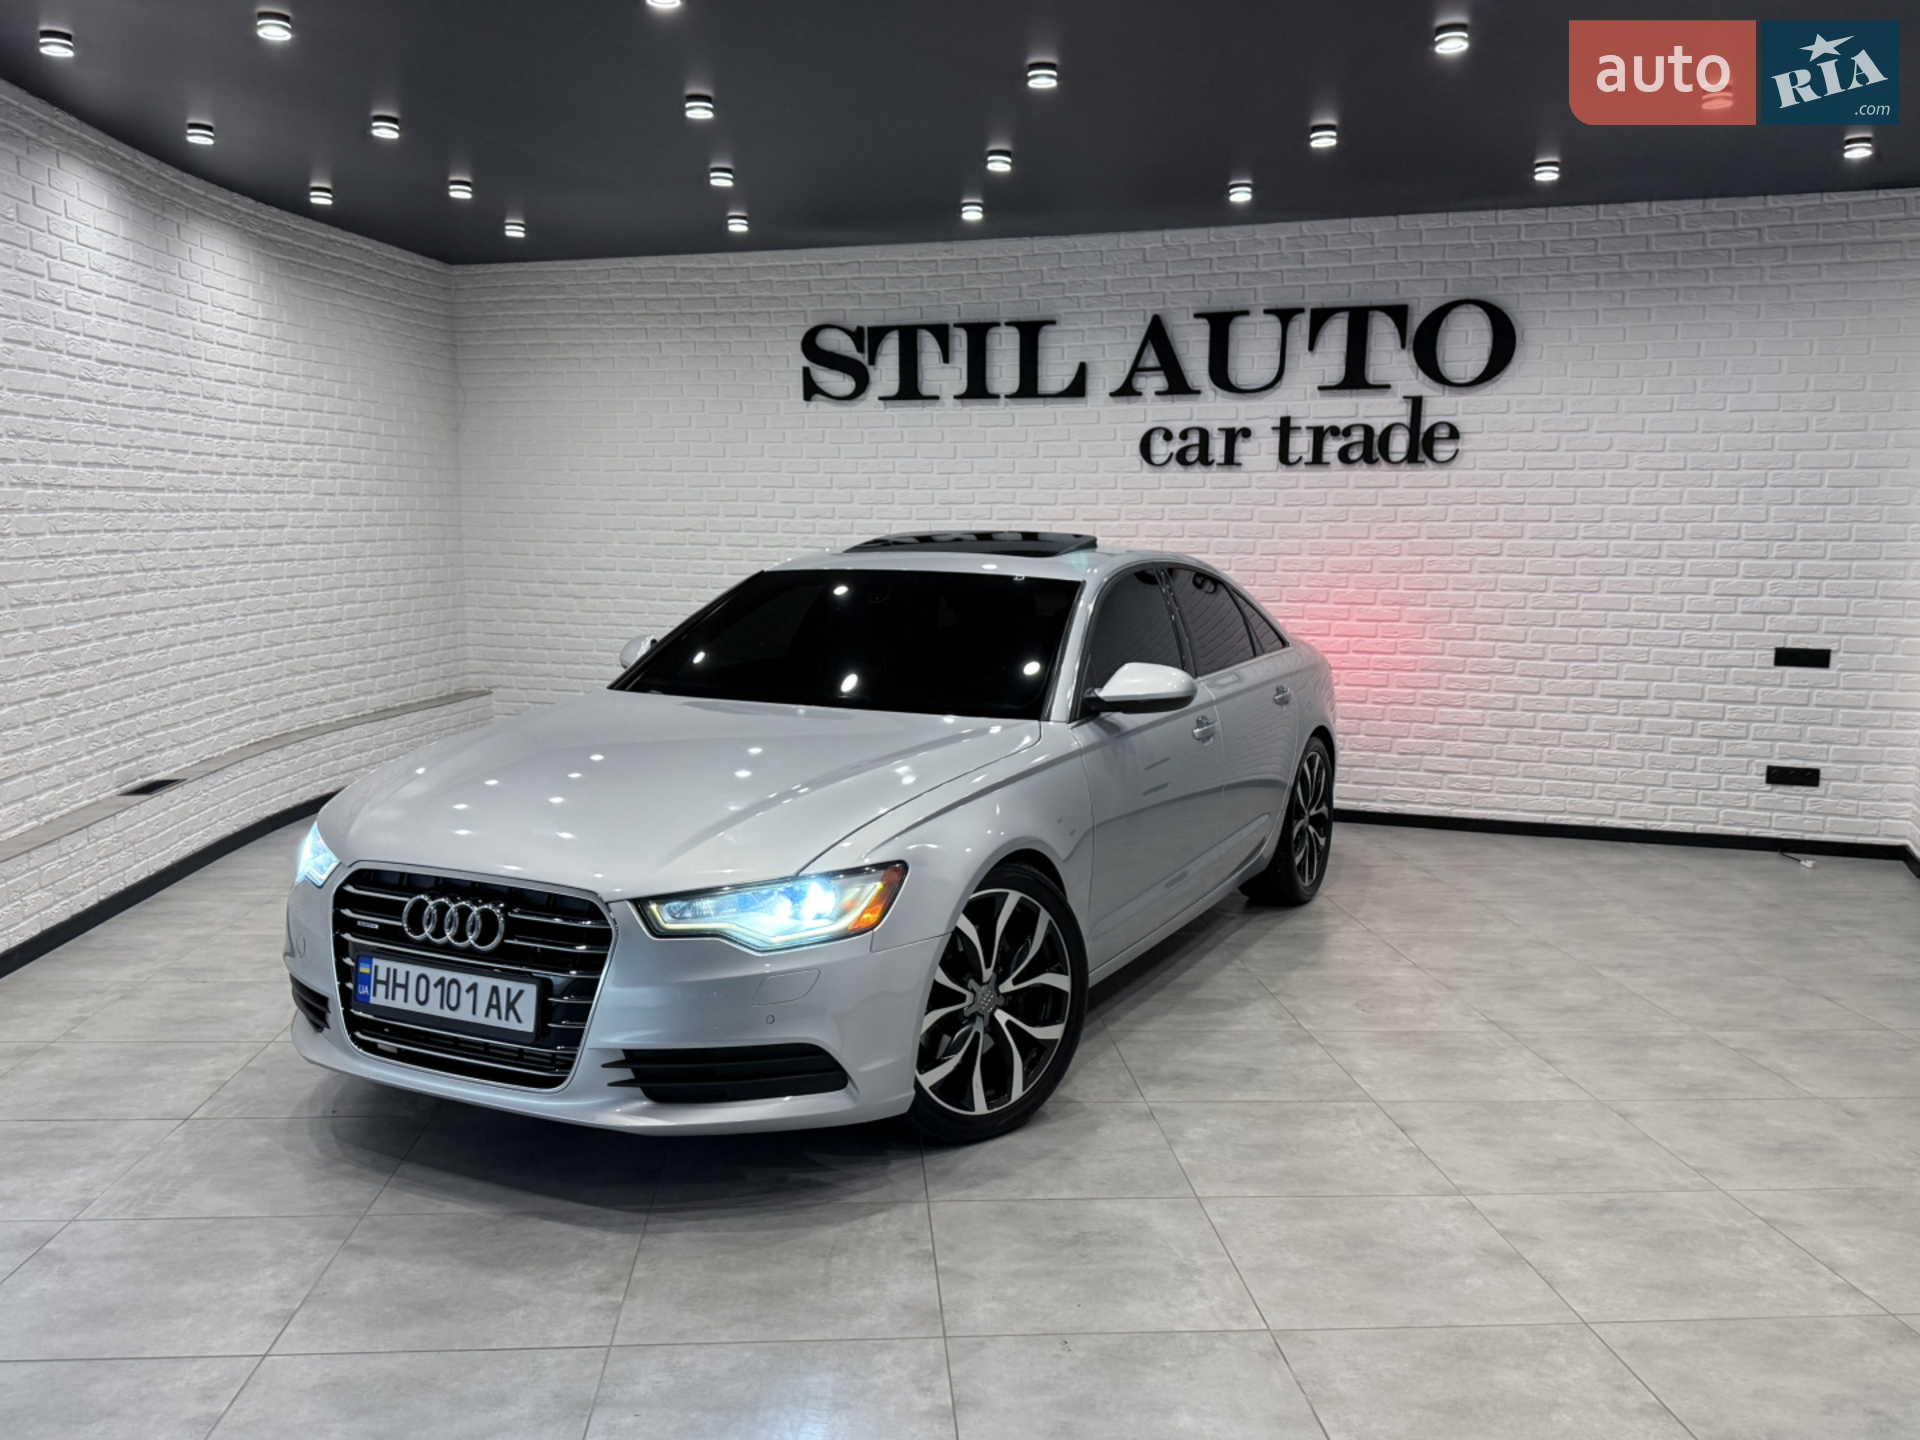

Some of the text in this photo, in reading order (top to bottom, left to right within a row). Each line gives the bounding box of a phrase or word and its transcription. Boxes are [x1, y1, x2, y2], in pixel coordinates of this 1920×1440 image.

[801, 299, 1517, 402] STIL AUTO
[1140, 396, 1461, 467] car trade
[358, 984, 370, 995] UA
